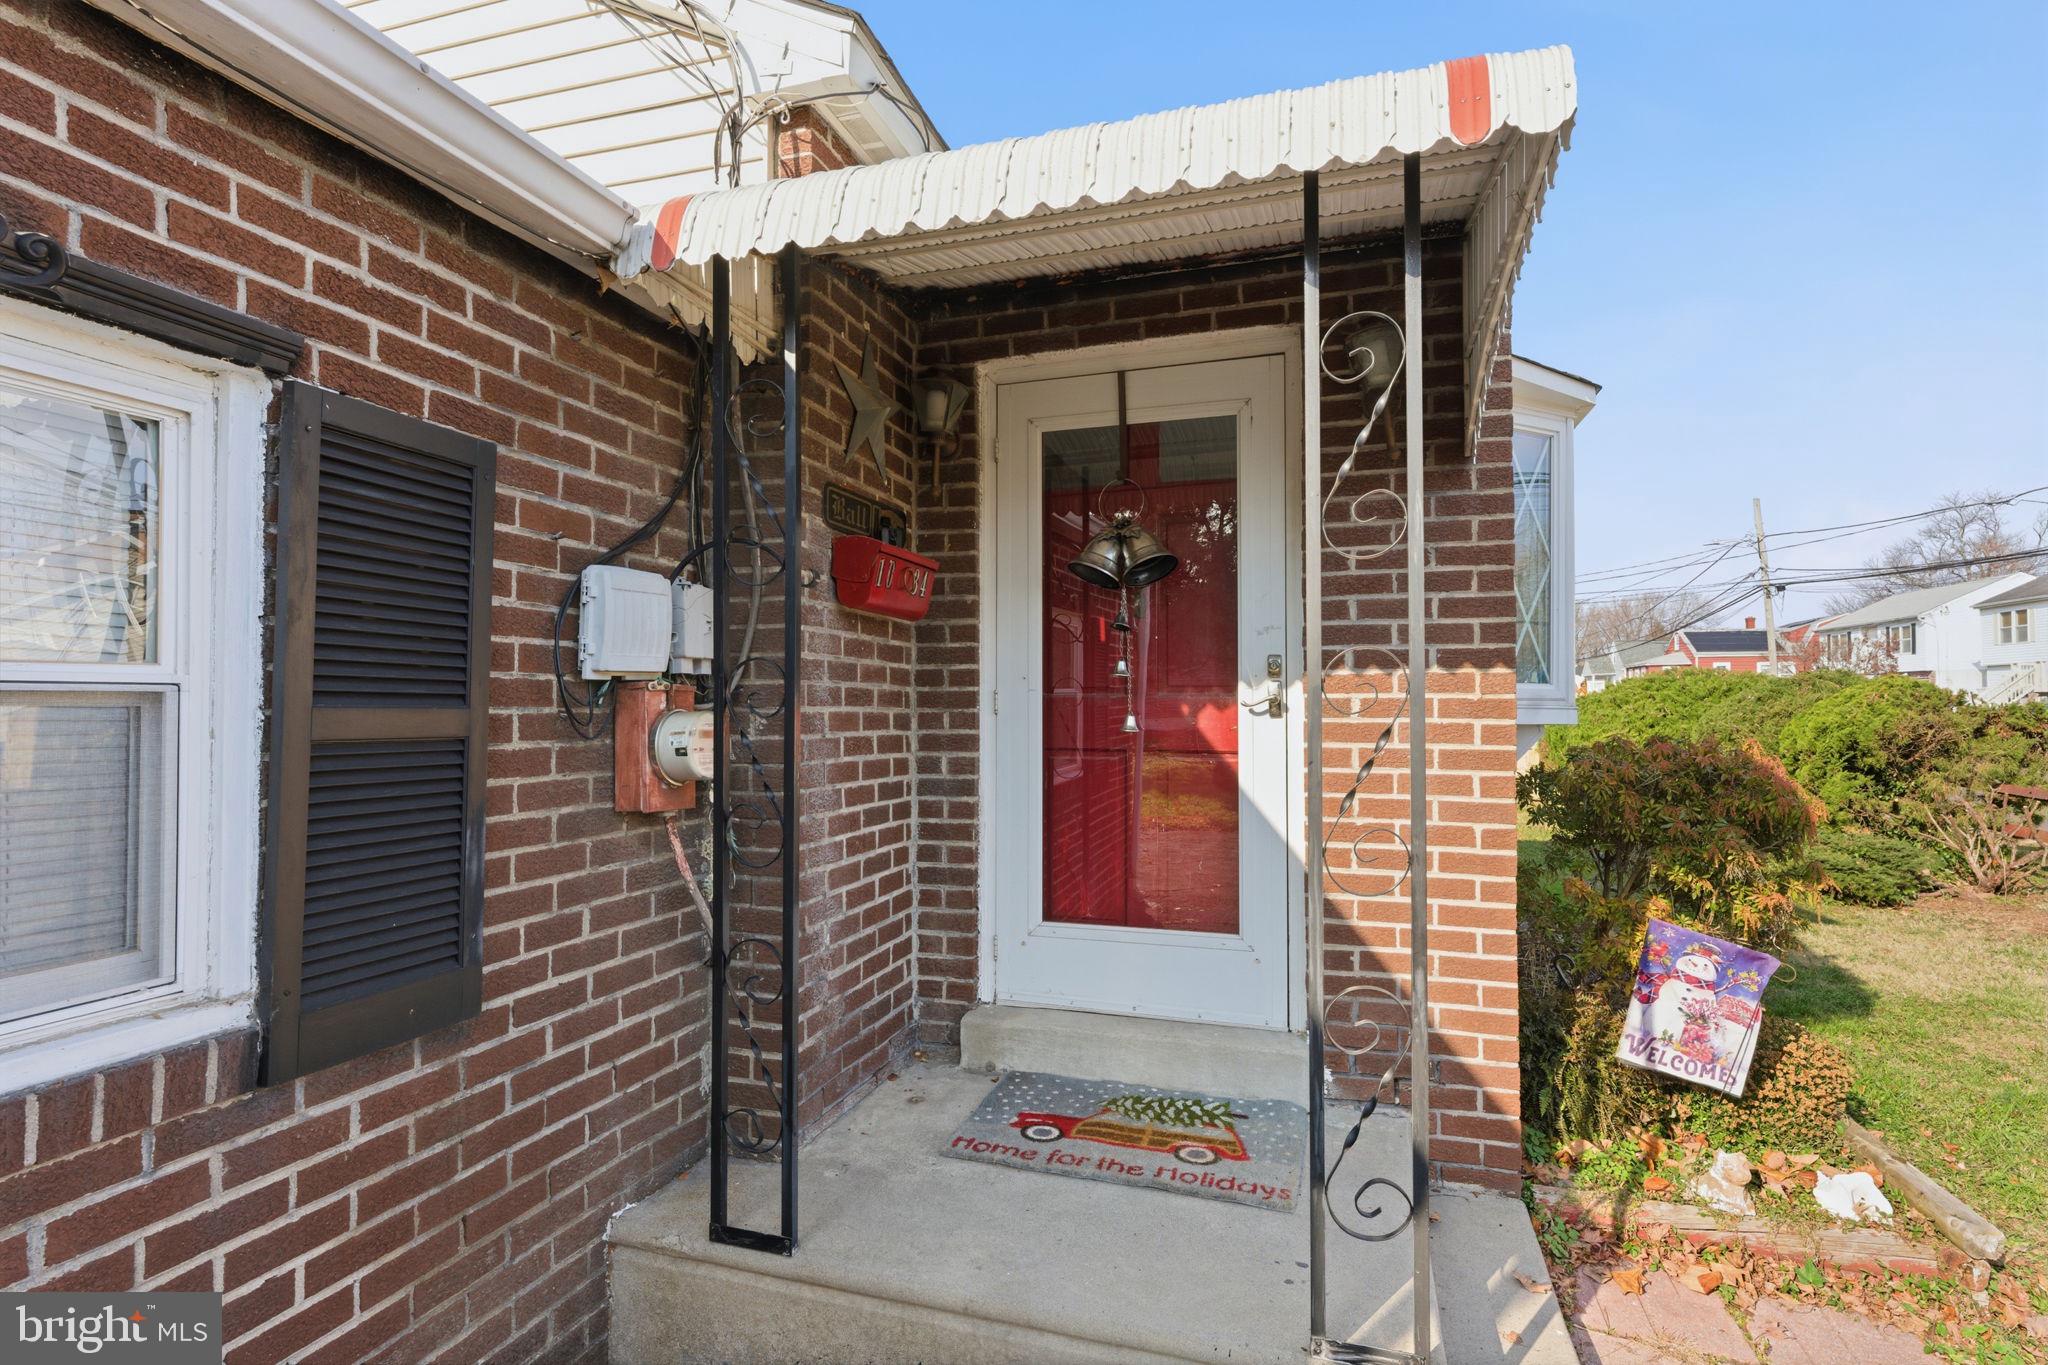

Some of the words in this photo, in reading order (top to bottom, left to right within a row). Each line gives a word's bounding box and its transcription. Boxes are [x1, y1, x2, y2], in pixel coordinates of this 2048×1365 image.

[1625, 1033, 1738, 1086] WELCOME
[952, 1135, 1039, 1161] Home
[1046, 1149, 1091, 1167] for
[1097, 1157, 1144, 1177] the
[1154, 1166, 1292, 1200] Holidays
